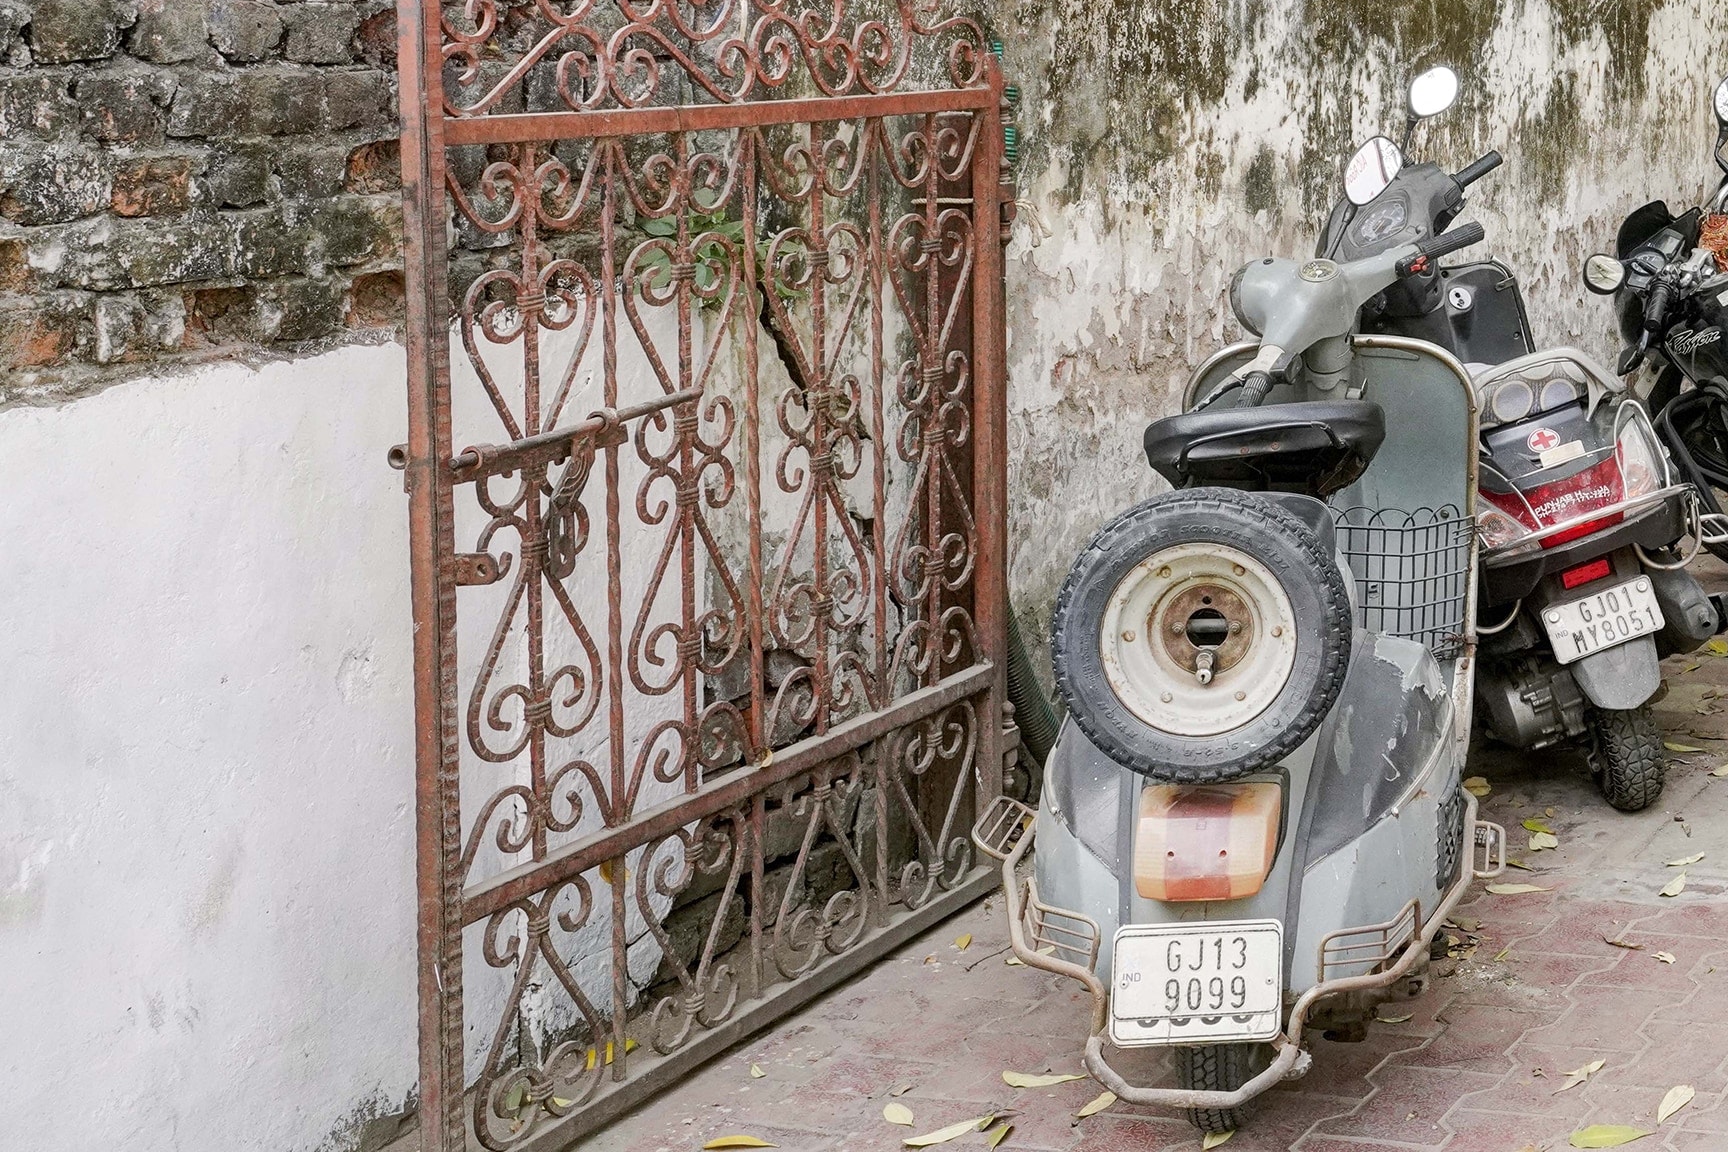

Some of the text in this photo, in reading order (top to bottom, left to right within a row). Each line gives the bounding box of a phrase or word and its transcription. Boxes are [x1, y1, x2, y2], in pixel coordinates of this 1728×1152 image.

[1578, 586, 1633, 623] GJ01
[1554, 629, 1569, 639] IND
[1571, 606, 1656, 654] MY8051
[1166, 936, 1247, 972] GJ13
[1122, 971, 1141, 983] IND
[1164, 975, 1246, 1012] 9099
